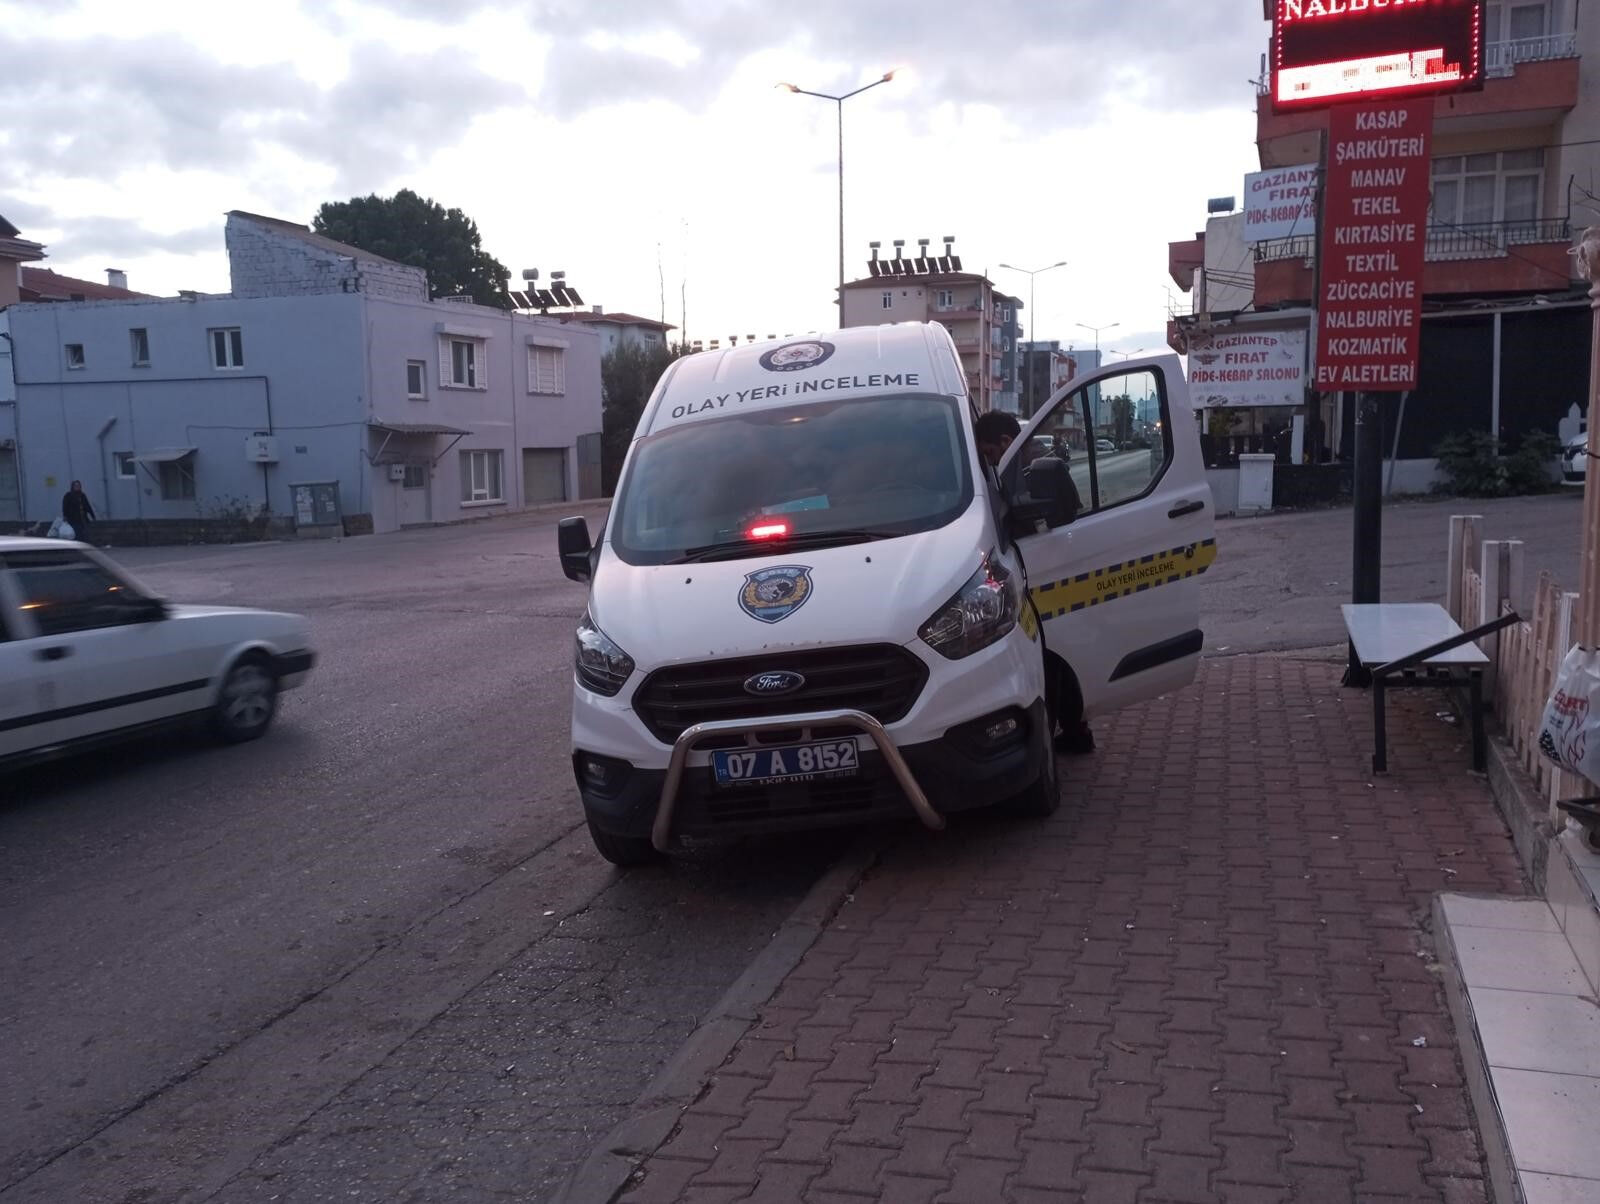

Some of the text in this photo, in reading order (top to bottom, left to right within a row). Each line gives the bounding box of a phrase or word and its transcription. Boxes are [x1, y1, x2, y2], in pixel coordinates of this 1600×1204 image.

[1356, 110, 1408, 130] KASAP
[1336, 133, 1424, 165] ŞARKÜTERİ
[1351, 168, 1406, 188] MANAV
[1352, 196, 1401, 216] TEKEL
[1335, 220, 1416, 245] KIRTASİYE
[1346, 249, 1399, 272] TEXTİL
[1327, 277, 1415, 300] ZÜCCACİYE
[1326, 305, 1413, 328] NALBURİYE
[1328, 333, 1408, 356] KOZMATİK
[1225, 351, 1269, 365] FIRAT
[1257, 367, 1300, 381] SALONU
[1318, 360, 1415, 383] EV ALETLERİ
[671, 393, 730, 419] OLAY
[1096, 578, 1117, 591] OLAY
[756, 674, 790, 690] Ford
[727, 752, 757, 779] 07
[770, 750, 788, 776] A
[797, 742, 856, 772] 8152
